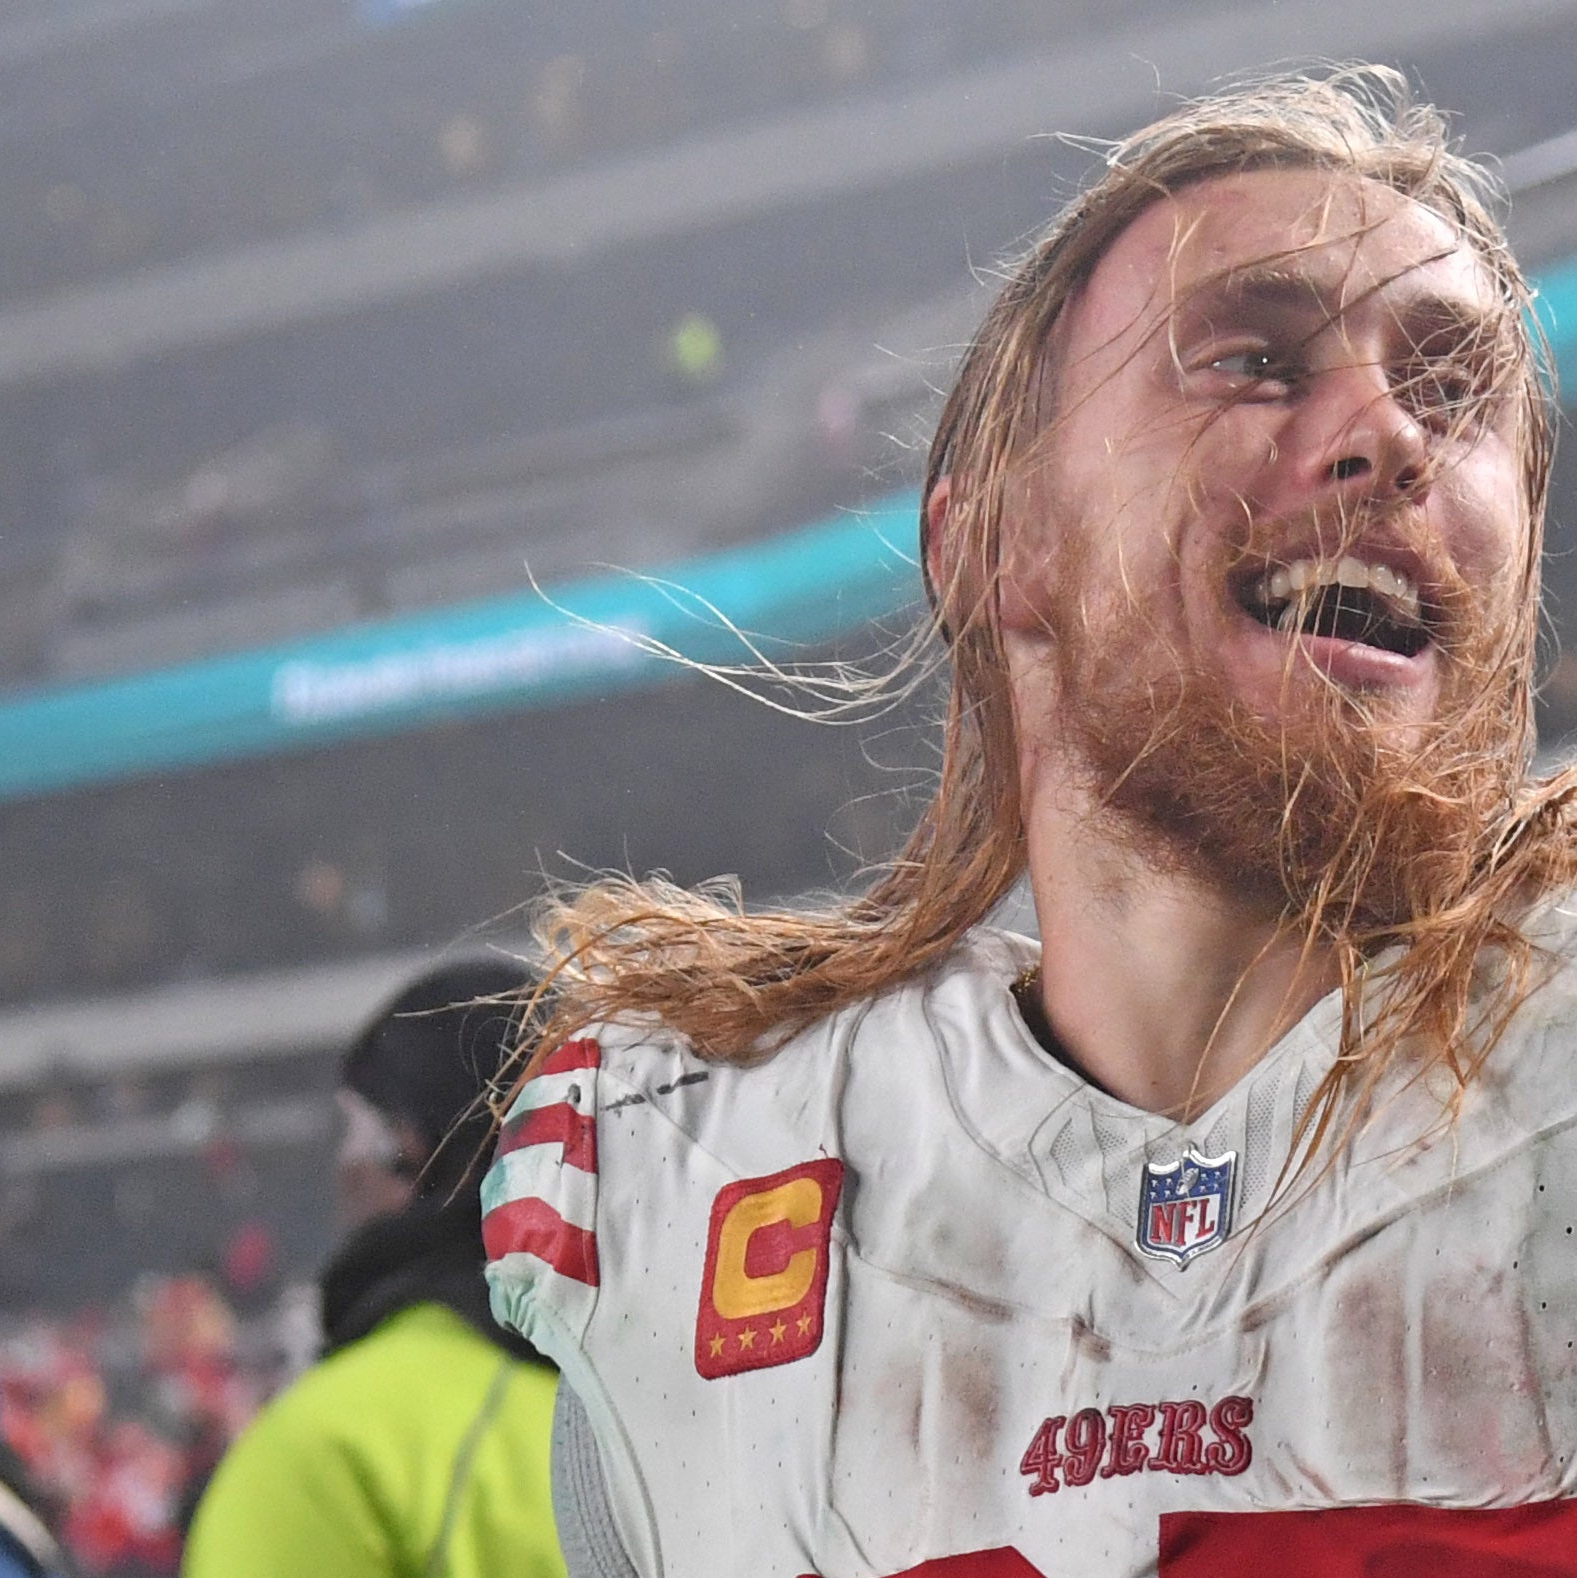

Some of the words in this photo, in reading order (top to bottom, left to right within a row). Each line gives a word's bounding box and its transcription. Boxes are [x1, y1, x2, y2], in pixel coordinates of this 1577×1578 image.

[712, 1177, 823, 1320] C
[1150, 1198, 1216, 1246] NFL
[1020, 1396, 1254, 1497] 49ERS
